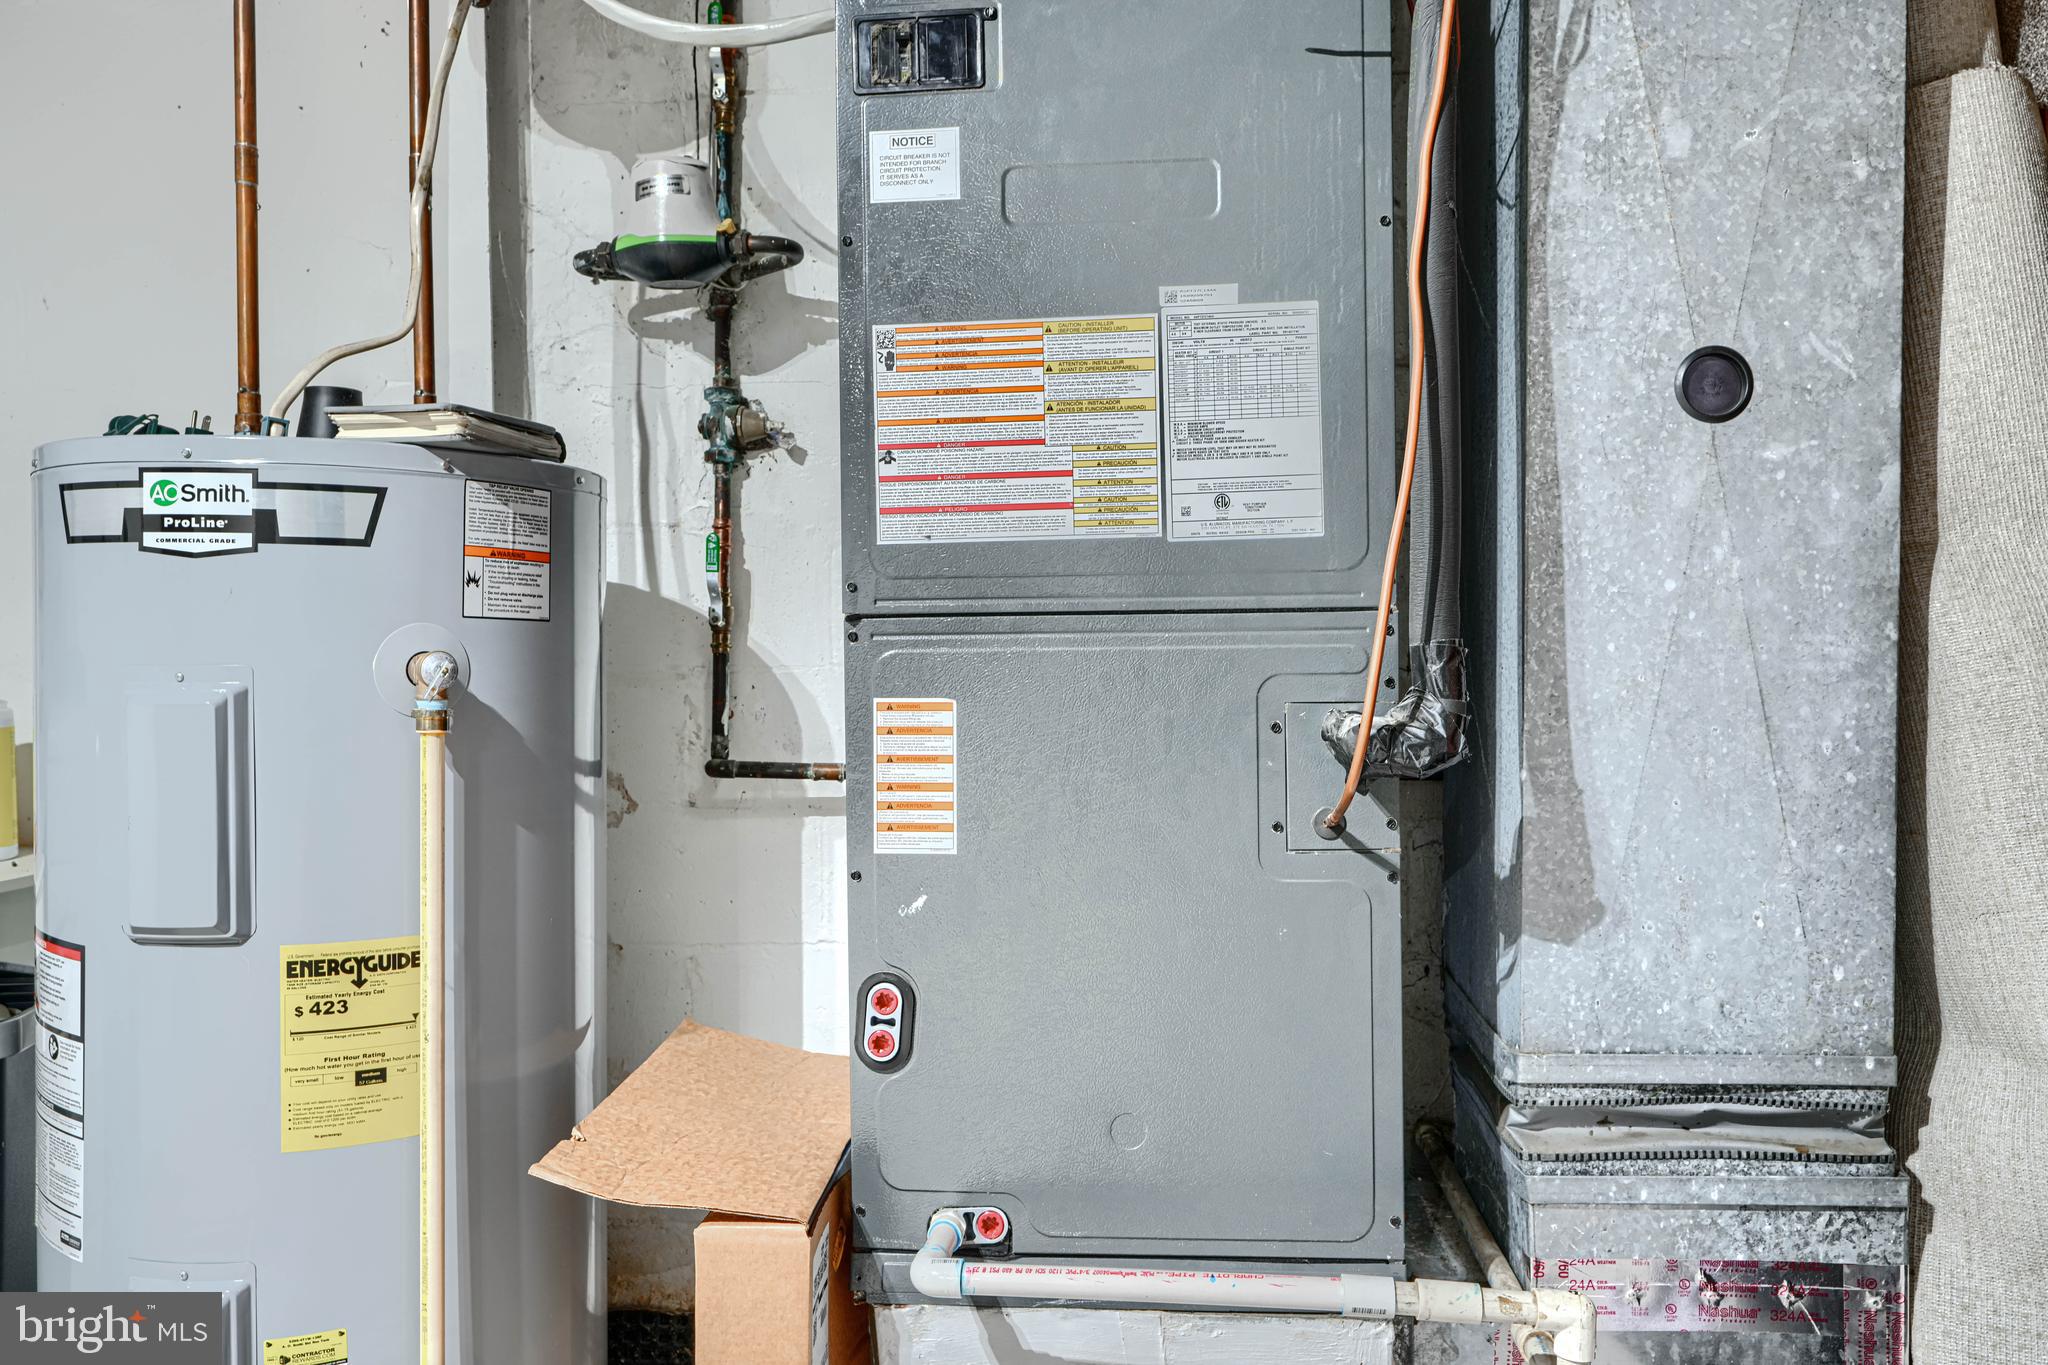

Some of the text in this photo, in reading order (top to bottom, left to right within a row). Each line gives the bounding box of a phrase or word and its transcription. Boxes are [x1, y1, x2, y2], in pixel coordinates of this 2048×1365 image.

[892, 136, 933, 147] NOTICE
[287, 950, 420, 982] ENERGYGUIDE
[335, 992, 351, 1000] Yearly
[295, 1000, 349, 1018] $ 423
[362, 1052, 386, 1060] Rating
[1698, 1305, 1806, 1322] Nashua 324A
[292, 1348, 335, 1358] CONTRACTOR
